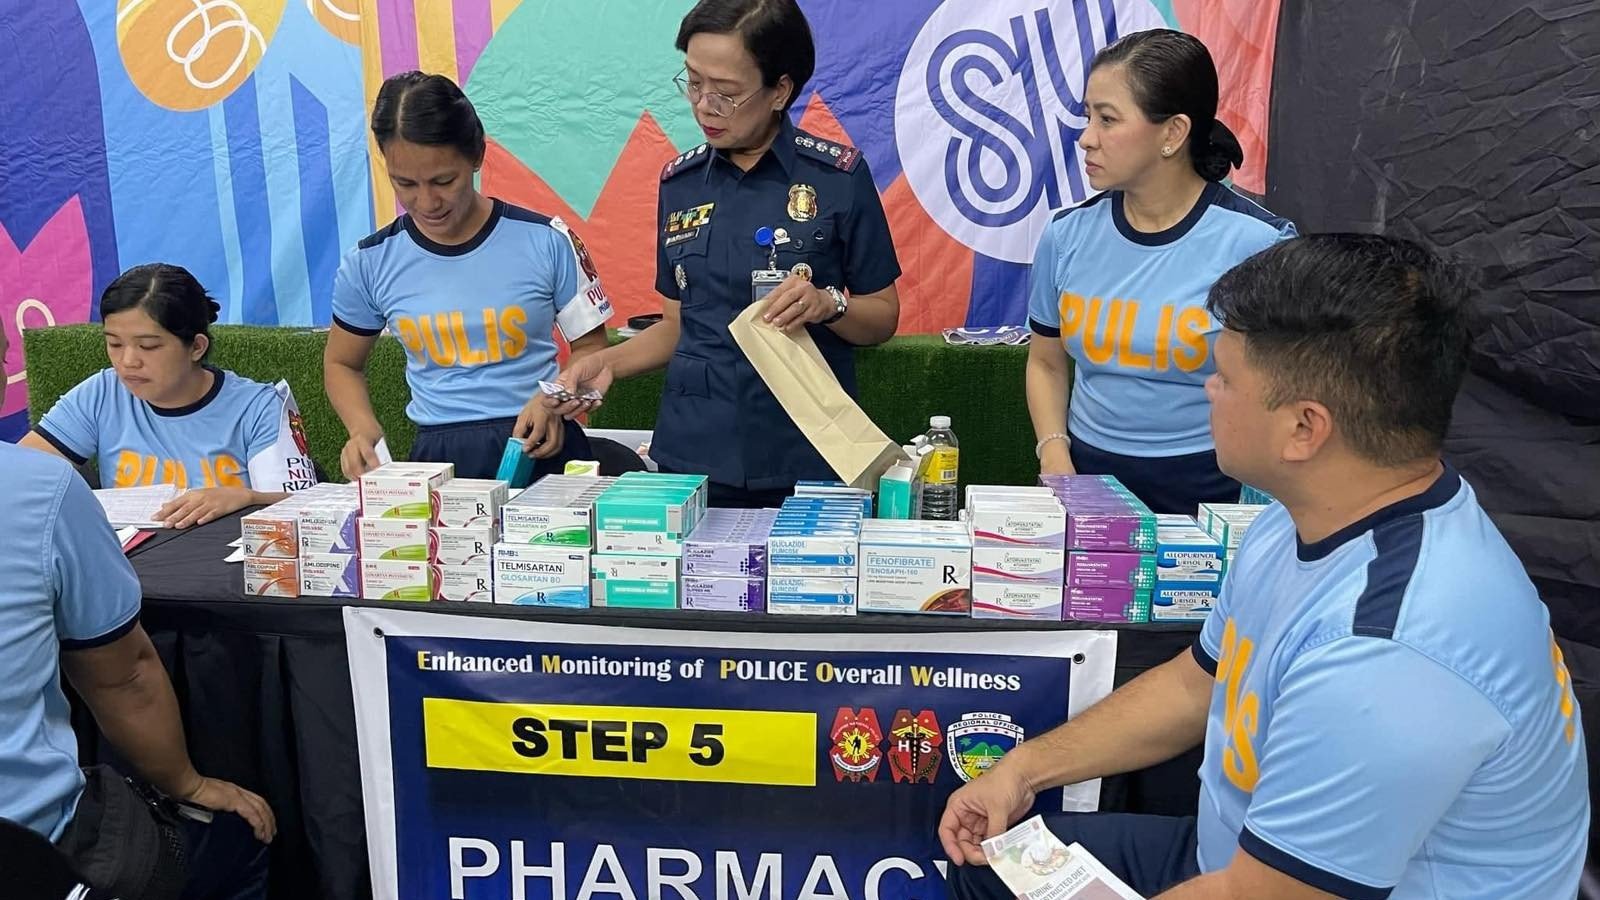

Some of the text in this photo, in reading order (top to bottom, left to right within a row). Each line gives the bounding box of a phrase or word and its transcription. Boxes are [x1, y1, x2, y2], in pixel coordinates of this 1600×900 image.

[397, 305, 528, 368] PULIS
[1060, 291, 1211, 373] PULIS
[500, 561, 562, 573] TELMISARTAN
[867, 567, 918, 575] FENOSAPH-160
[870, 557, 932, 567] FENOFIBRATE
[501, 574, 548, 583] GLOSARTAN
[417, 651, 1021, 691] Enhanced Monitoring of POLICE Overall Wellness
[953, 720, 1020, 731] REGIONAL OFFICE
[511, 717, 725, 766] STEP 5
[449, 836, 948, 900] PHARMAC
